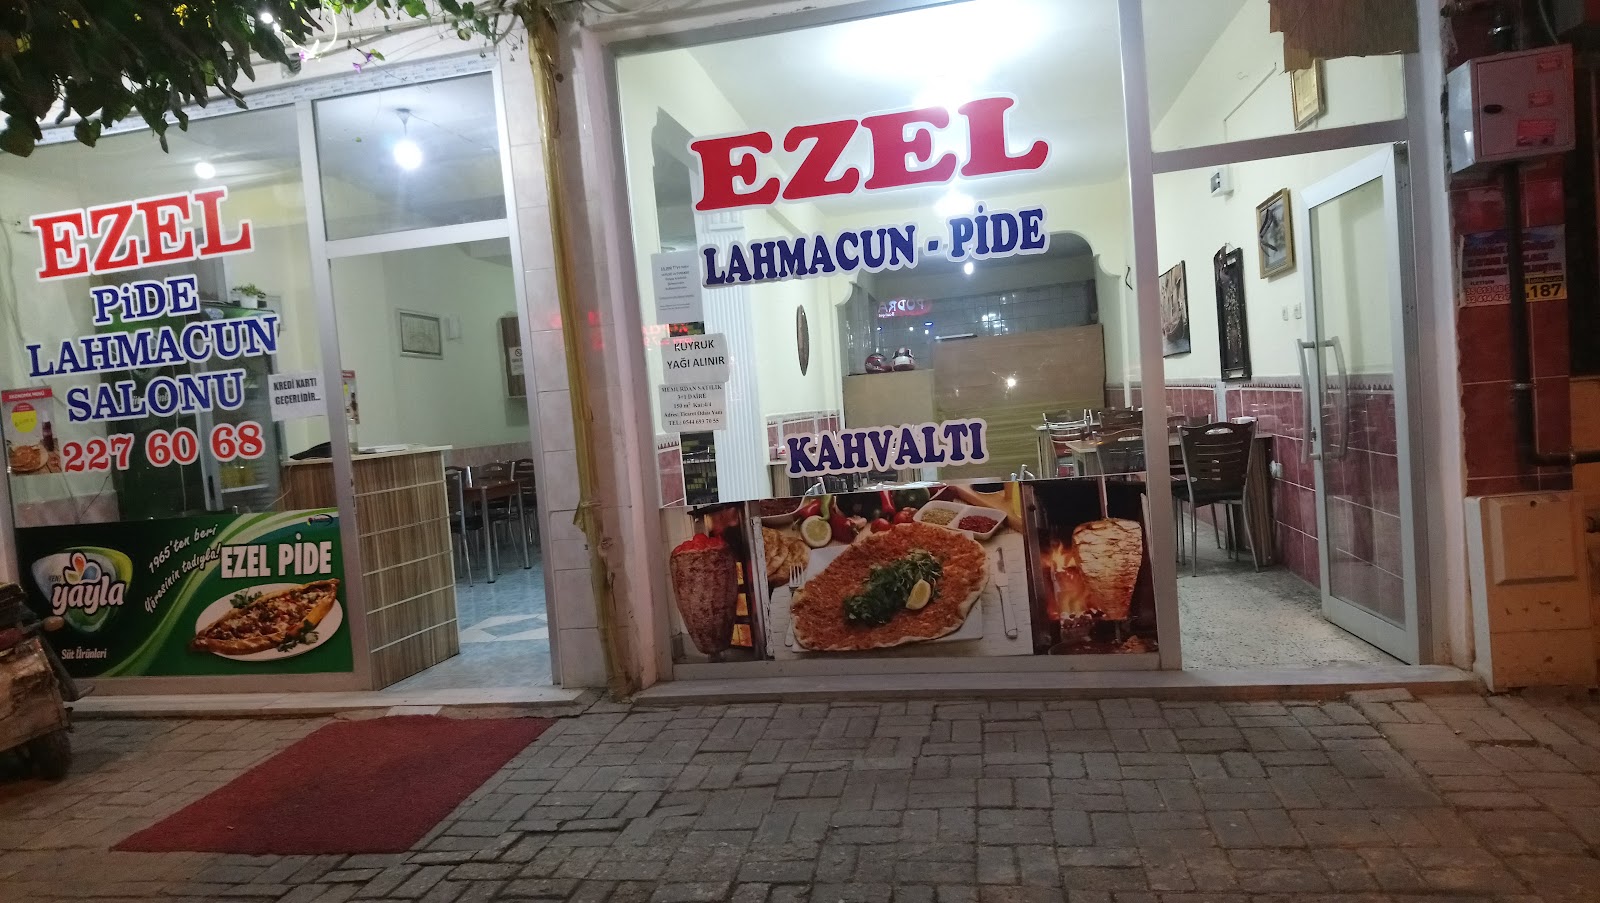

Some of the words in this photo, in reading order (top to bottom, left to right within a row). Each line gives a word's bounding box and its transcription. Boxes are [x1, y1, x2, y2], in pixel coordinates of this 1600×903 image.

[690, 96, 1049, 212] EZEL
[32, 189, 252, 279] EZEL
[703, 224, 916, 286] LAHMACUN
[950, 204, 1046, 258] PİDE
[1530, 283, 1562, 298] 187
[26, 316, 278, 377] LAHMACUN
[667, 357, 690, 370] YAĞI
[692, 356, 726, 368] ALINIR
[674, 339, 715, 352] KUYRUK
[66, 371, 244, 422] SALONU
[273, 378, 295, 391] KREDİ
[296, 377, 317, 389] KARTI
[63, 435, 133, 473] 227
[147, 430, 197, 466] 60
[212, 423, 263, 459] 68
[787, 422, 985, 474] KAHVALTI
[193, 523, 219, 541] beri
[221, 544, 271, 579] EZEL
[278, 532, 332, 576] PİDE
[51, 574, 126, 617] yayla
[61, 648, 75, 660] Süt
